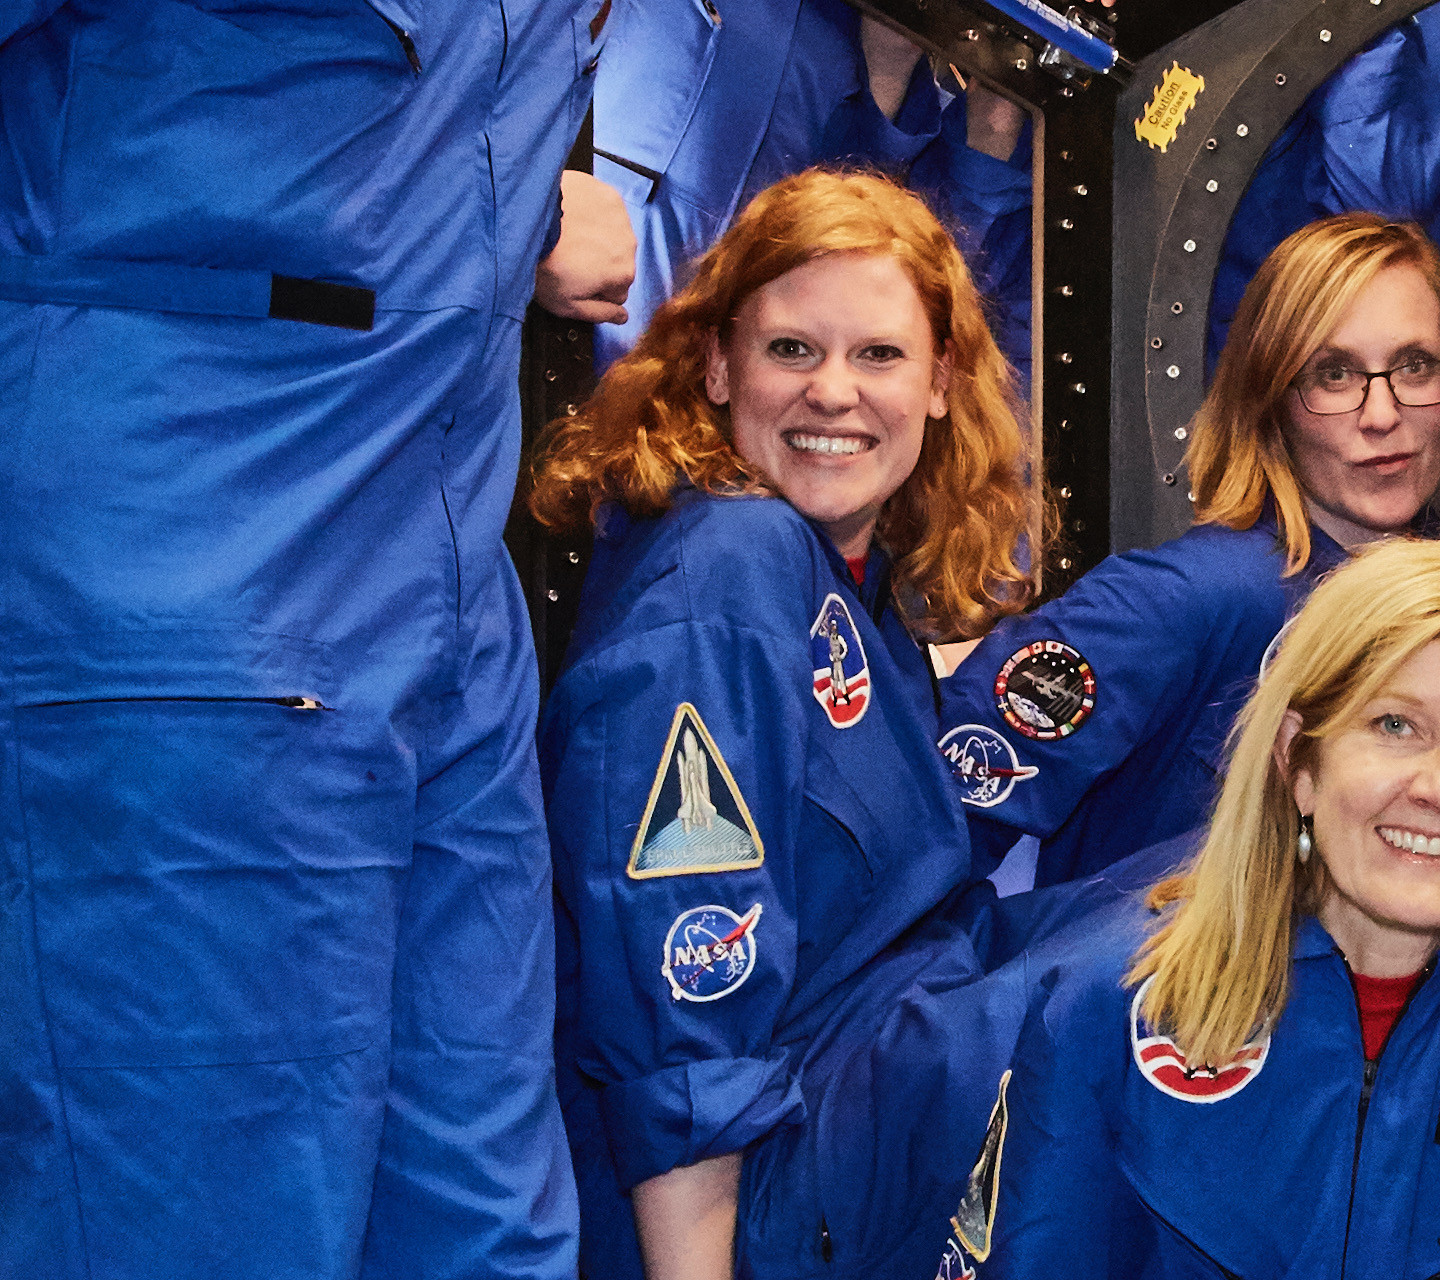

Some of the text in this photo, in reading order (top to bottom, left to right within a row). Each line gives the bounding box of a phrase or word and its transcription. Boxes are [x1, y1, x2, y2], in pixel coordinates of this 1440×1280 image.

[1148, 81, 1180, 125] Caution
[1161, 90, 1188, 130] No Glass
[944, 742, 1001, 794] NASA
[675, 941, 748, 967] NASA
